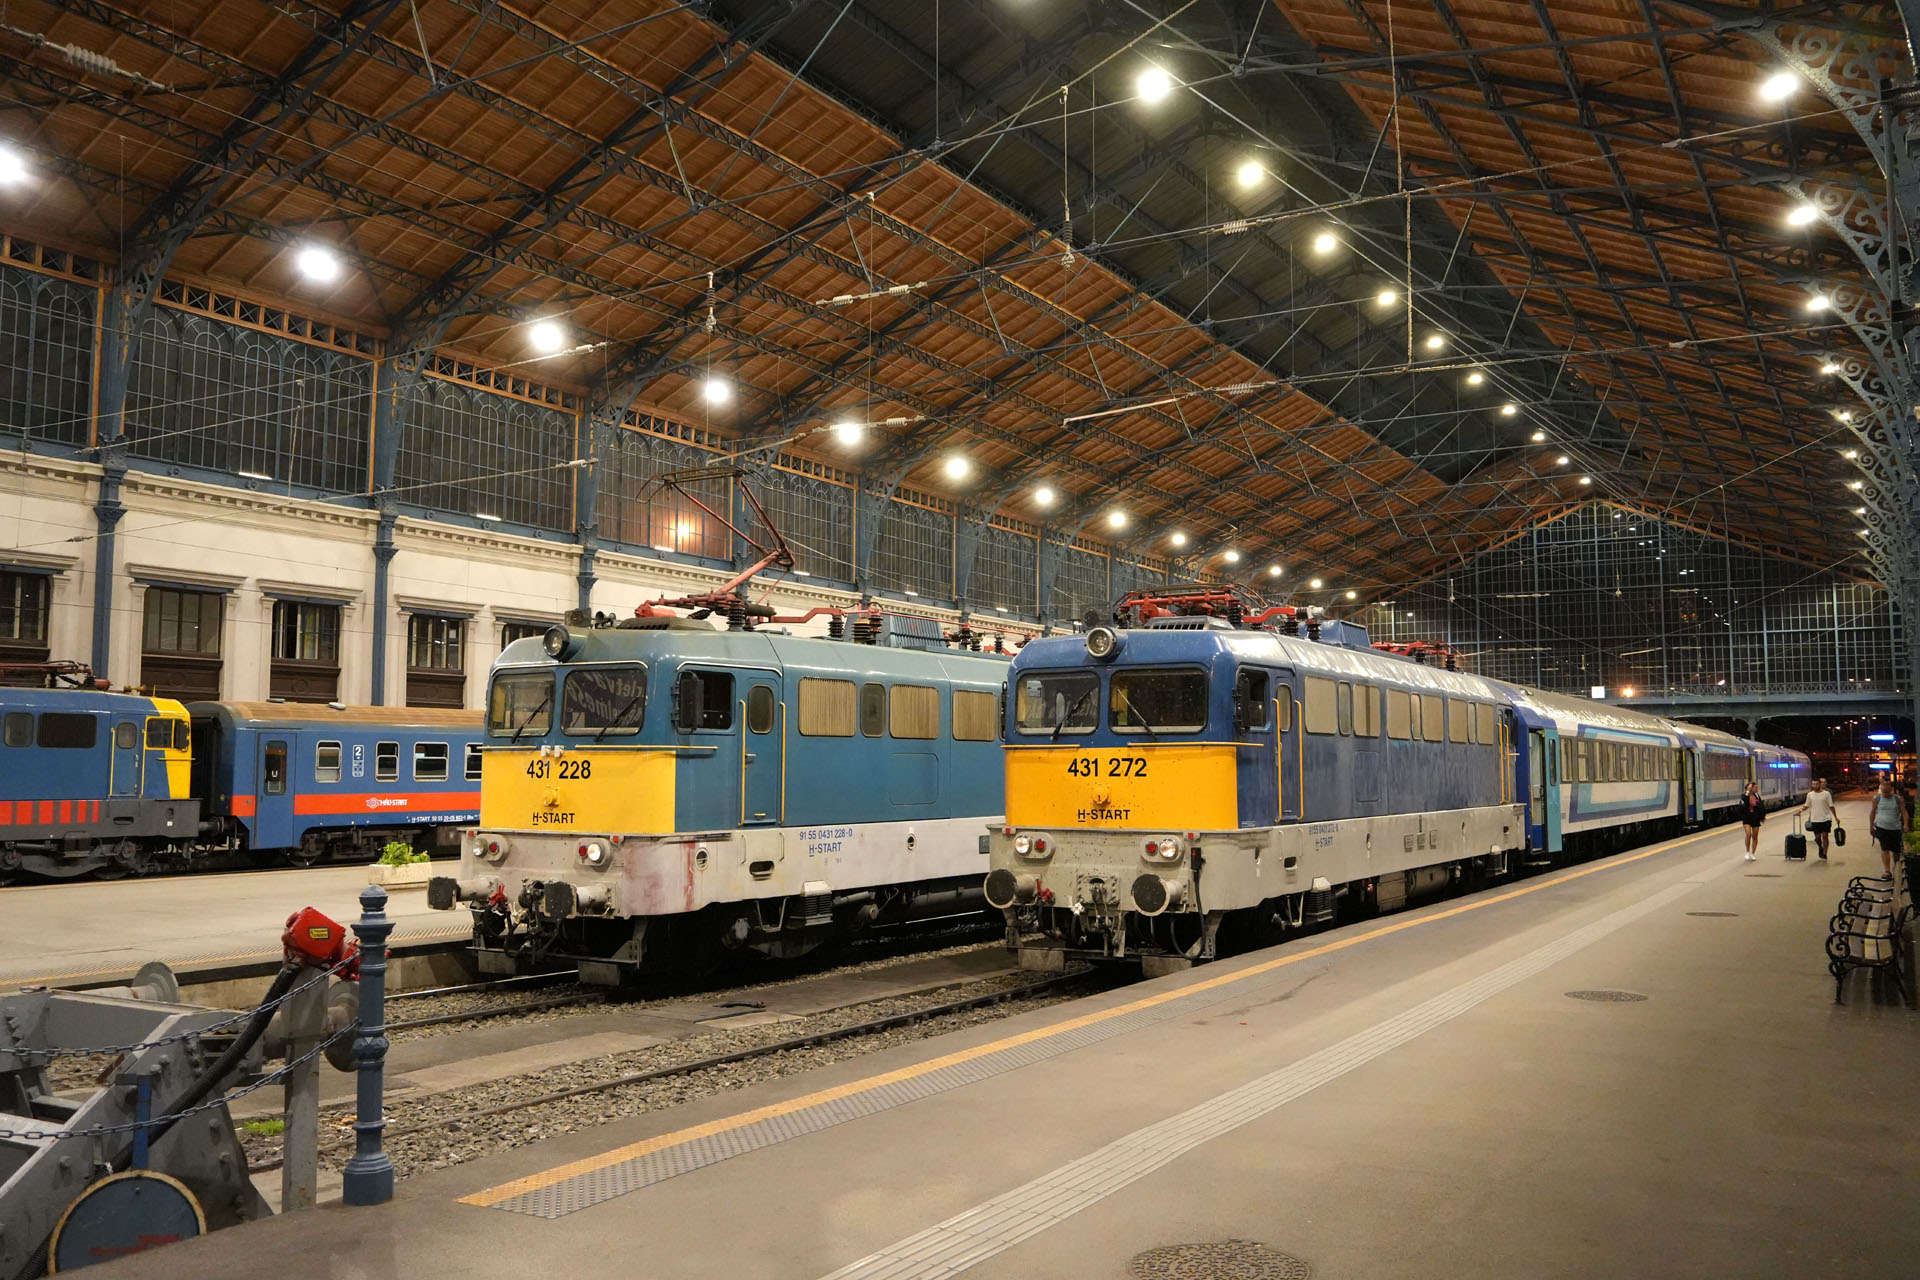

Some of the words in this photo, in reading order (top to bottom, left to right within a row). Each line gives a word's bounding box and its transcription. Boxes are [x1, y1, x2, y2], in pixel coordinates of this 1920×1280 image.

[355, 746, 361, 756] 2
[527, 760, 550, 779] 431
[559, 760, 591, 779] 228
[1067, 758, 1099, 777] 431
[1108, 758, 1147, 777] 272
[532, 812, 575, 825] H-START
[1078, 809, 1131, 822] H-START
[800, 831, 806, 840] 91
[808, 830, 816, 839] 55
[818, 829, 833, 839] 0431
[834, 828, 853, 839] 228-0
[809, 842, 842, 857] H-START
